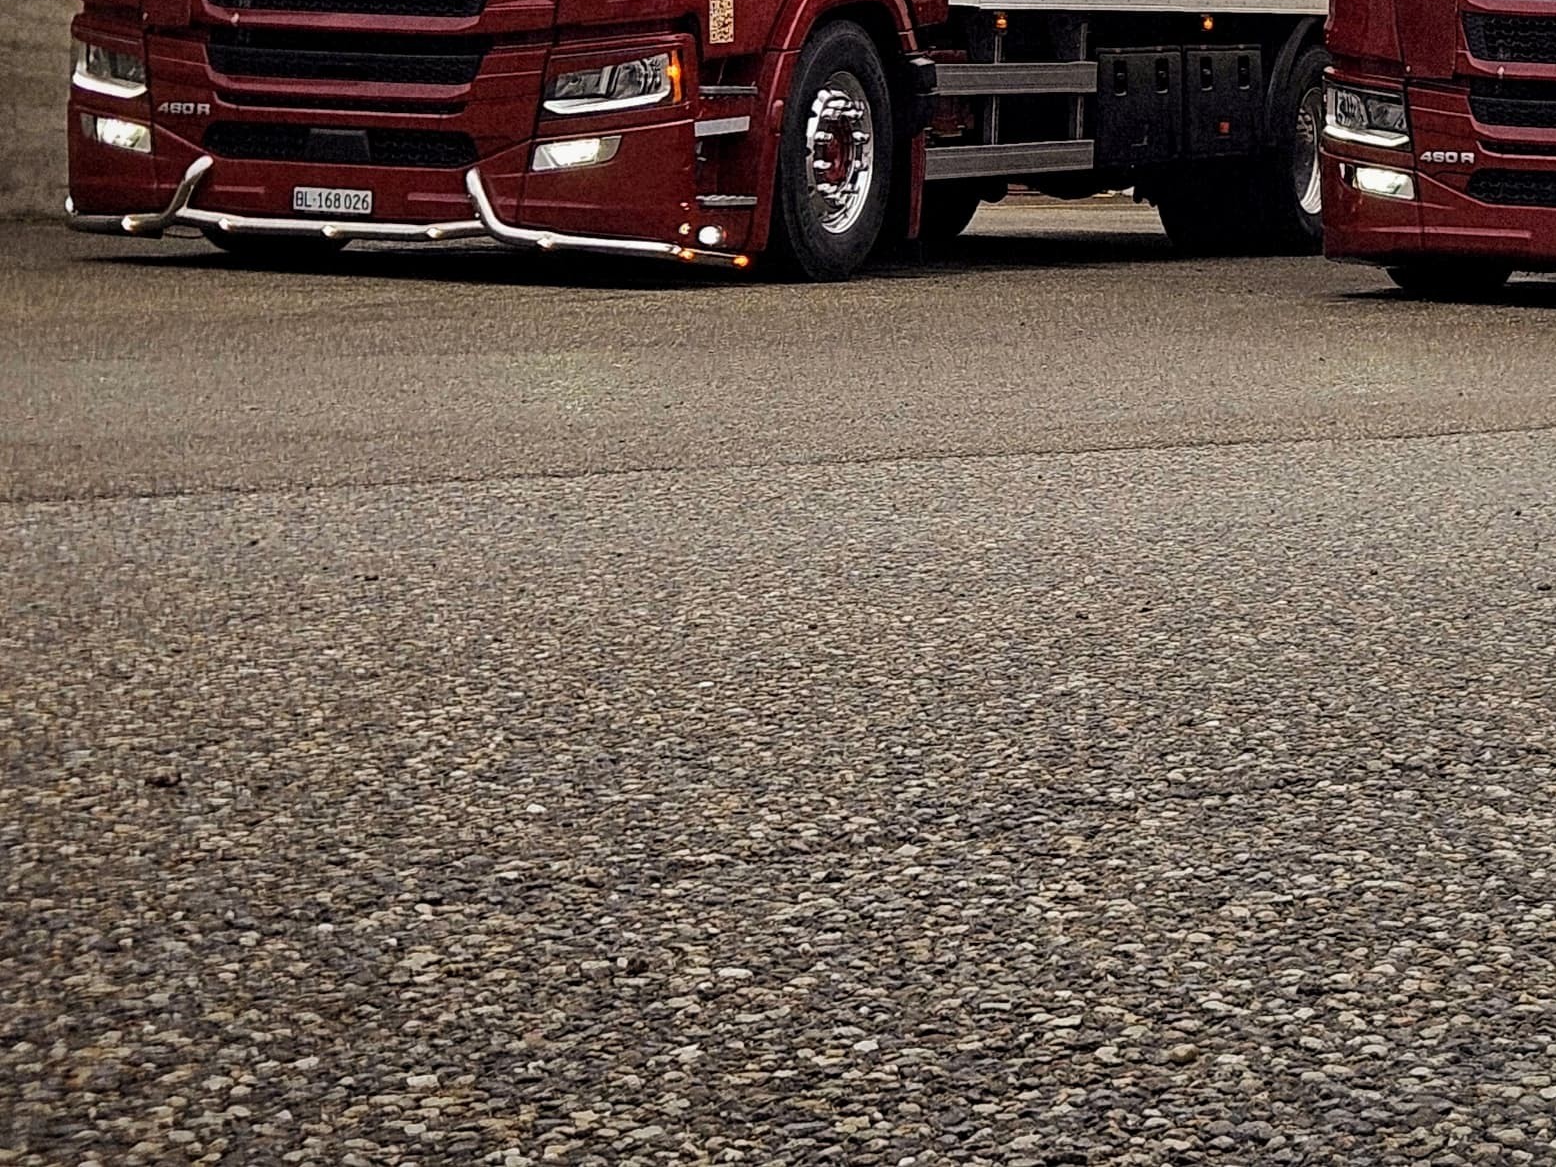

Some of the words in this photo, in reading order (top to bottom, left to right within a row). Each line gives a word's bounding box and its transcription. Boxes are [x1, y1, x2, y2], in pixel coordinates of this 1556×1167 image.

[196, 102, 211, 116] R
[1460, 152, 1475, 164] R
[343, 193, 370, 211] 026
